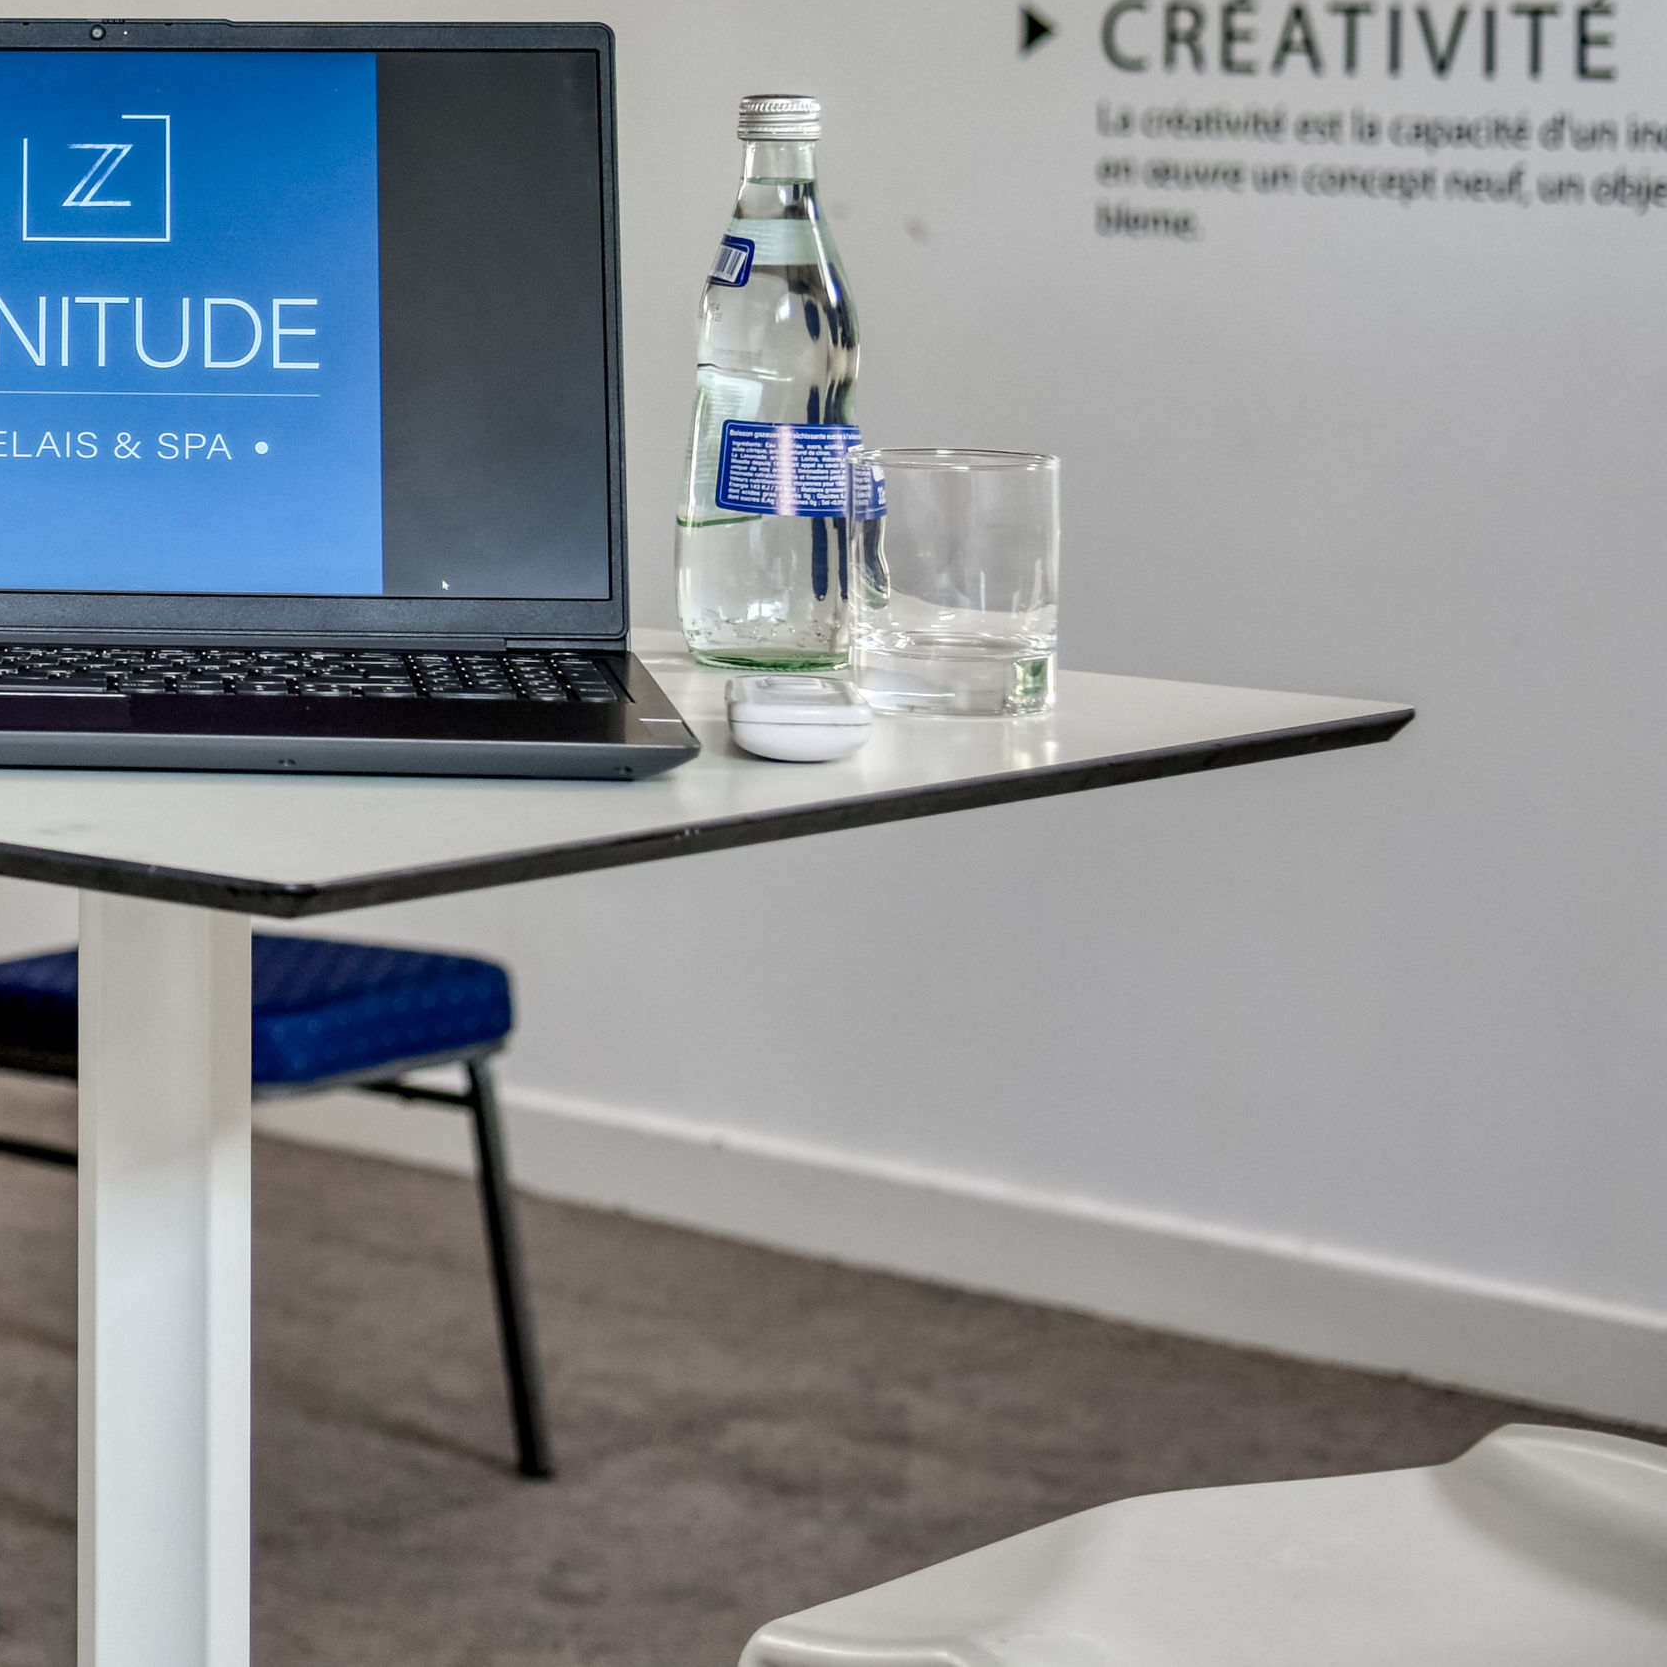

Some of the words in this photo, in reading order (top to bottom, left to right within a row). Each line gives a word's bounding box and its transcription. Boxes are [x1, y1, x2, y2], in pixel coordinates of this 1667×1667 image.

[1097, 100, 1135, 136] La
[112, 430, 143, 462] &
[155, 430, 234, 463] SPA
